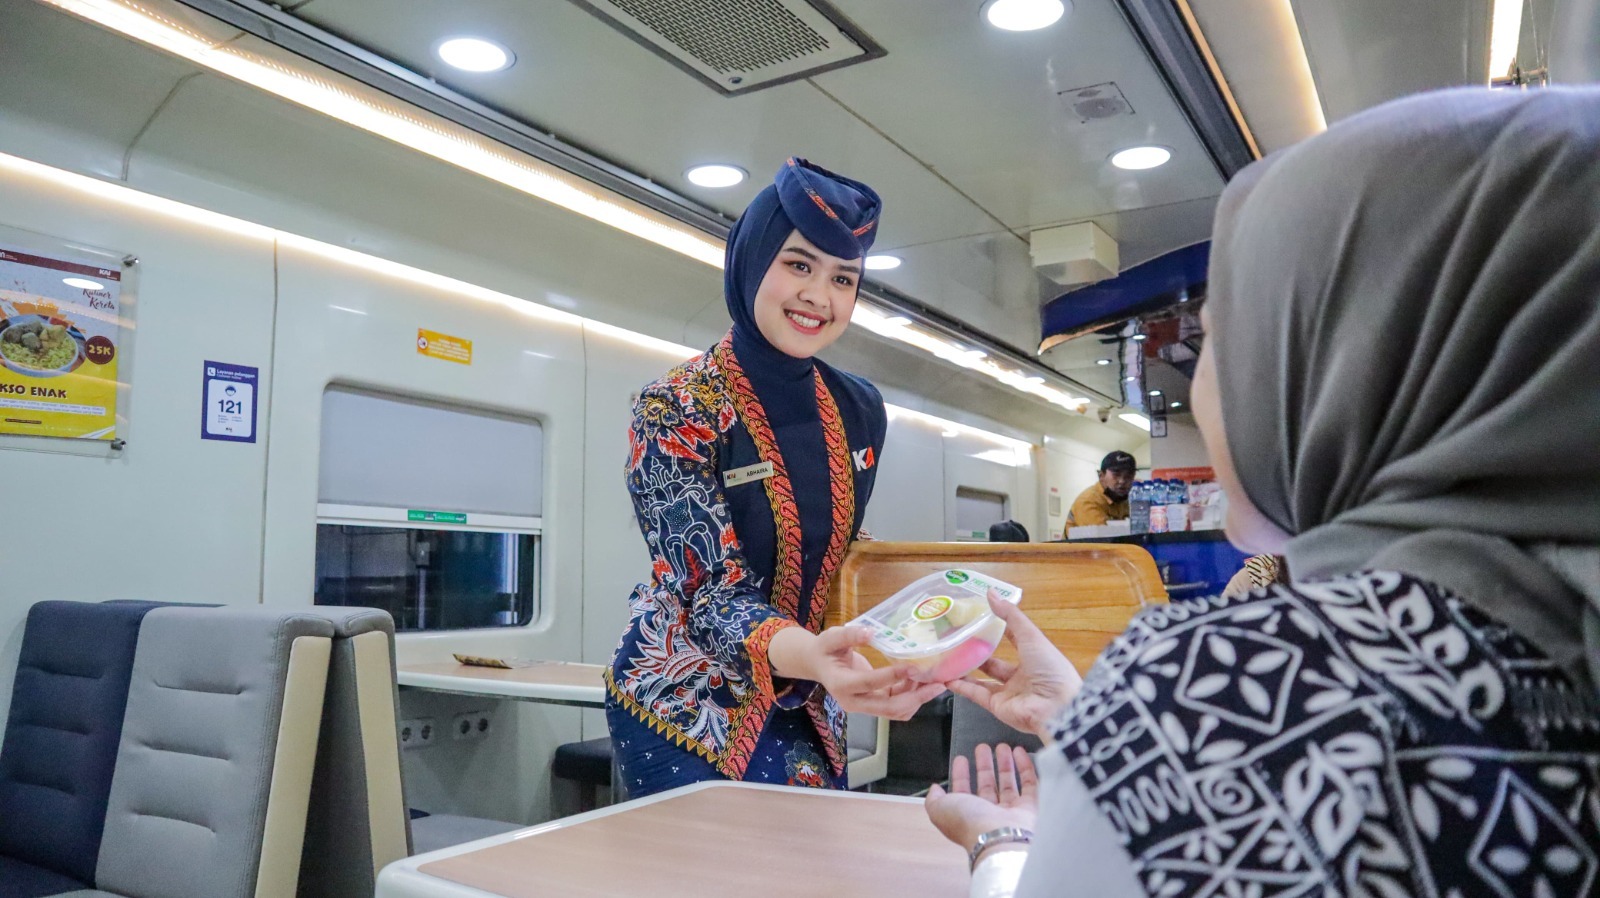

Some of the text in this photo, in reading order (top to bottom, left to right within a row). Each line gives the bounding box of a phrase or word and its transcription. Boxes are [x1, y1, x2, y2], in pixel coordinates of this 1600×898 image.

[90, 297, 115, 310] Kereta
[88, 344, 111, 355] 25K
[31, 386, 67, 399] ENAK
[217, 399, 242, 415] 121
